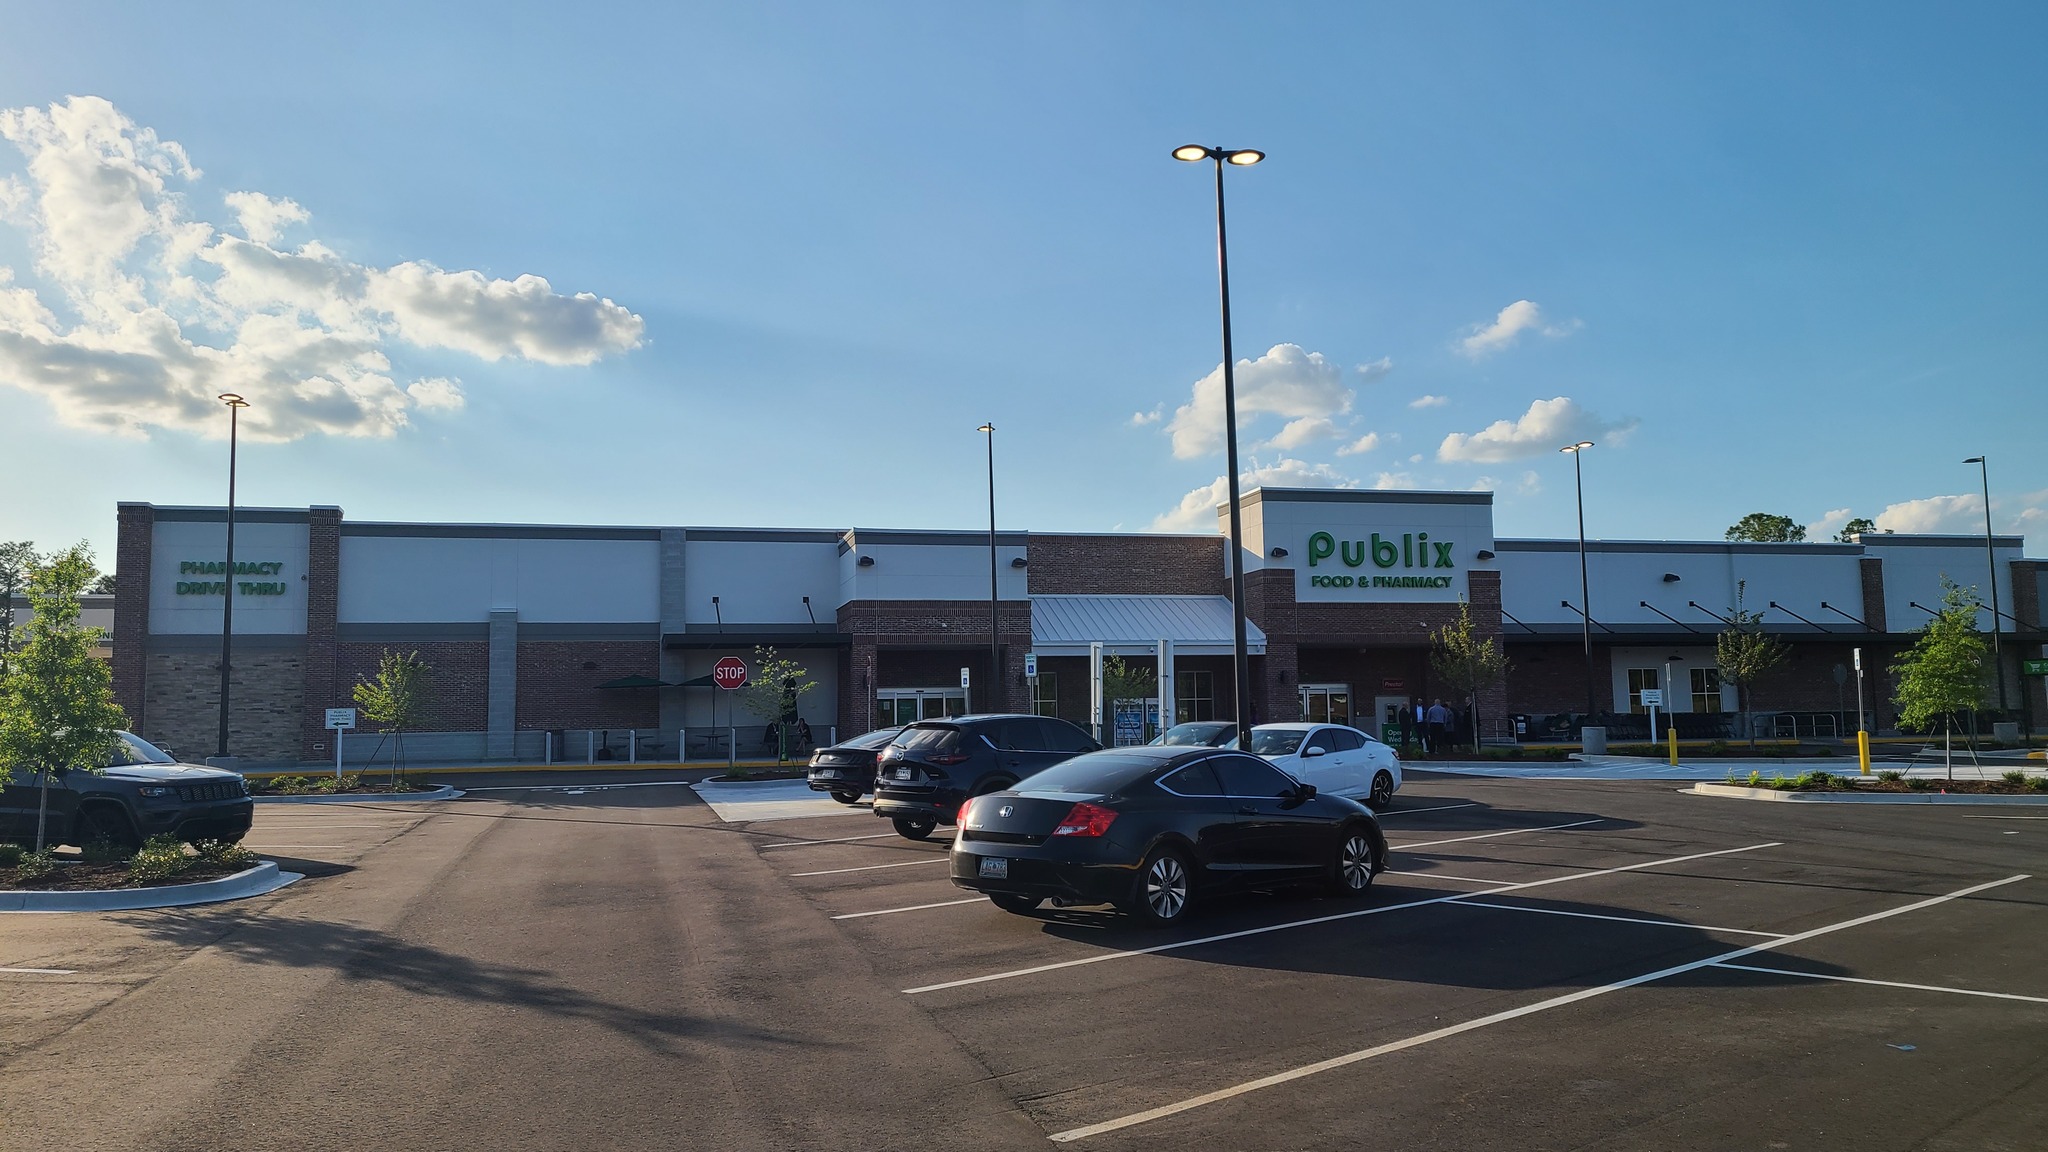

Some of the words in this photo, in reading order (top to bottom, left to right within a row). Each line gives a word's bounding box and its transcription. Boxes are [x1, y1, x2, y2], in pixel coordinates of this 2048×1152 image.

[1308, 531, 1455, 568] Publix
[180, 561, 283, 576] PHARMACY
[176, 581, 227, 596] DRIVE
[238, 582, 286, 596] THRU
[1311, 575, 1354, 587] FOOD
[1358, 575, 1370, 587] &
[1373, 576, 1453, 588] PHARMACY
[716, 666, 745, 680] STOP
